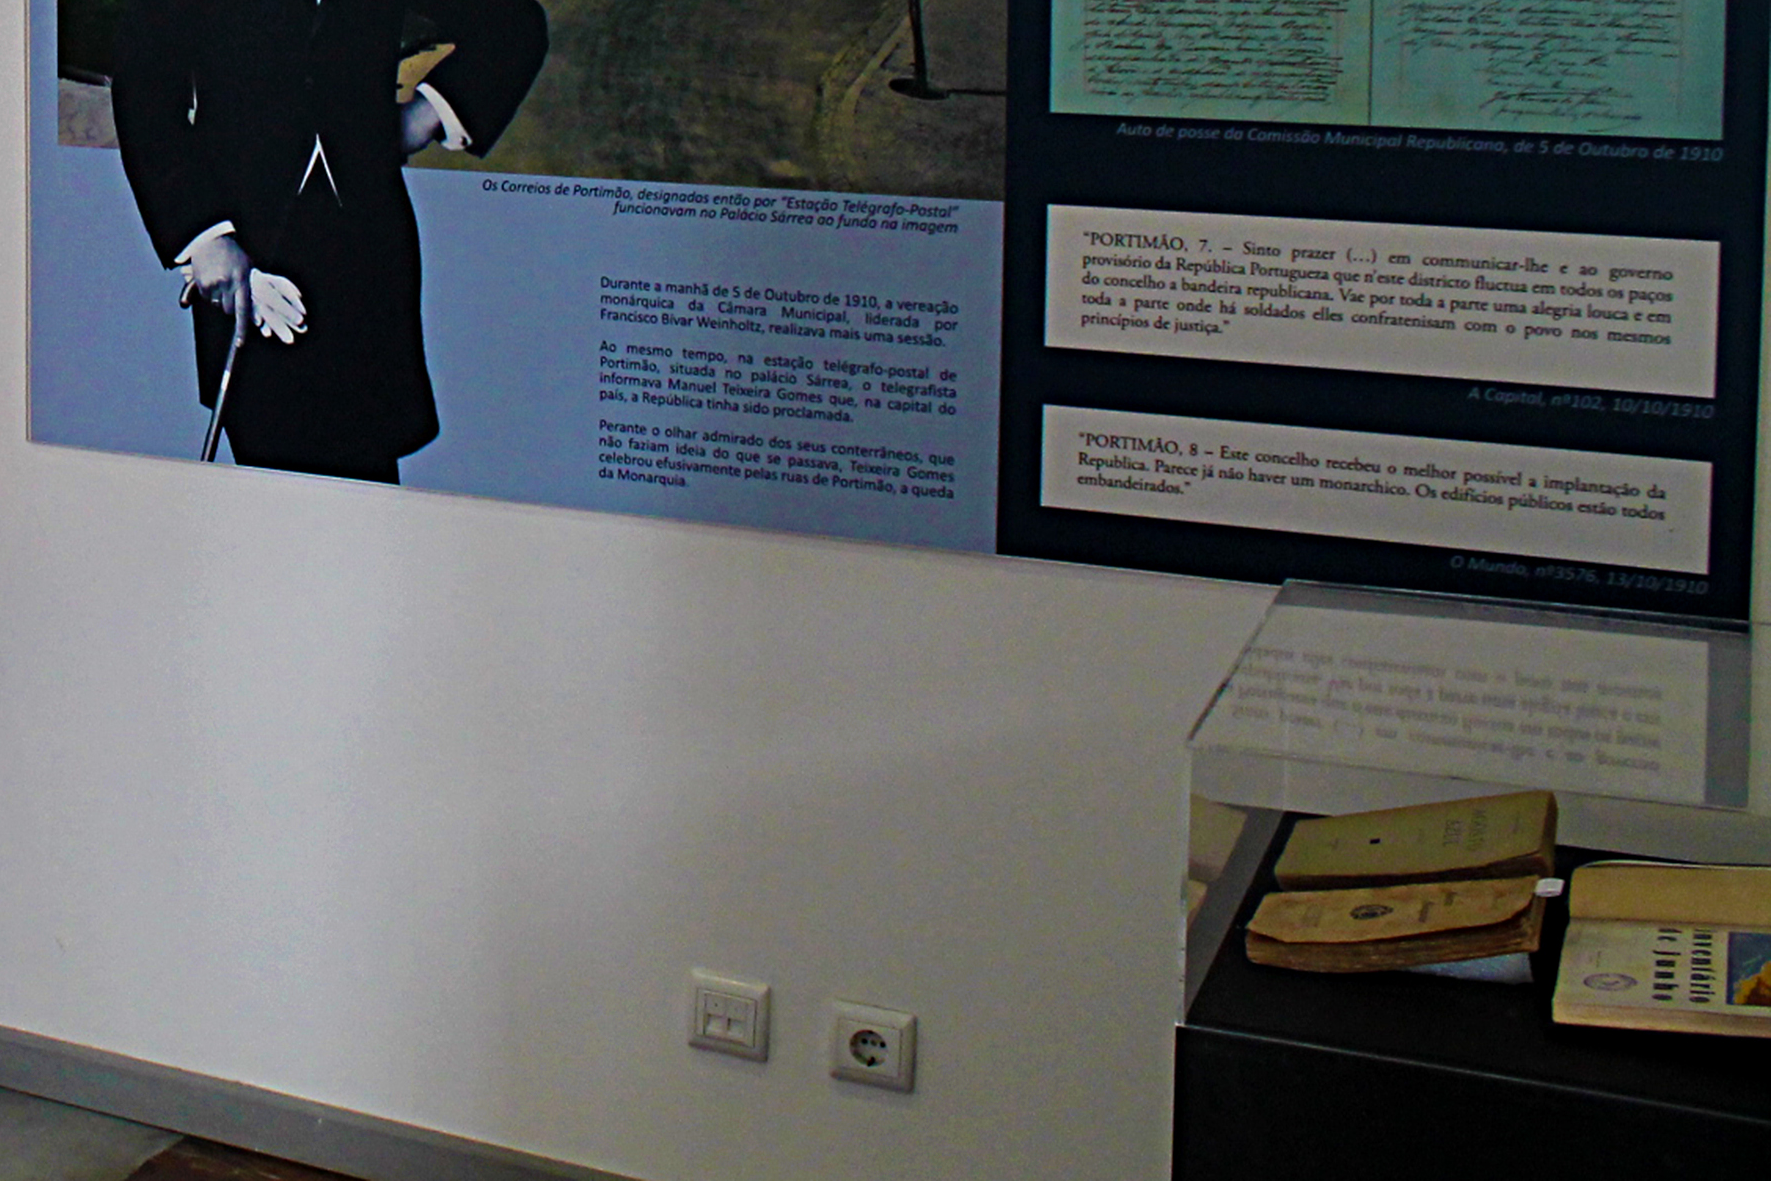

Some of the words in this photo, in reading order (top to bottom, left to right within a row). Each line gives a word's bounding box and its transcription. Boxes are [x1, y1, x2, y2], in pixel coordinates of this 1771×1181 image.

[482, 180, 497, 192] Os
[500, 181, 550, 195] Correios
[554, 183, 569, 196] de
[572, 184, 632, 203] Portimão,
[637, 188, 709, 207] designados
[712, 192, 749, 206] então
[753, 197, 775, 211] por
[612, 202, 696, 221] funcionavam
[699, 210, 717, 220] no
[719, 208, 767, 223] Palácio
[770, 211, 813, 226] Sárrea
[816, 216, 834, 227] ao
[836, 214, 877, 231] fundo
[880, 220, 898, 231] na
[901, 218, 958, 237] imagem
[1198, 238, 1211, 252] 7.
[1242, 240, 1281, 256] Sinto
[1290, 248, 1335, 263] prazer
[1387, 254, 1411, 264] em
[1421, 251, 1548, 272] communicar-lhe
[1558, 264, 1568, 273] e
[1579, 265, 1598, 275] ao
[1608, 267, 1673, 283] governo
[599, 293, 674, 313] monárquica
[687, 299, 704, 313] da
[717, 301, 766, 317] Câmara
[781, 305, 849, 326] Municipal,
[865, 311, 919, 328] liderada
[934, 320, 958, 334] por
[600, 277, 650, 293] Durante
[654, 284, 661, 294] a
[665, 281, 709, 297] manhã
[712, 284, 729, 298] de
[732, 286, 740, 299] 5
[743, 286, 760, 300] de
[763, 288, 820, 305] Outubro
[822, 292, 839, 306] de
[845, 293, 880, 312] 1910,
[885, 299, 893, 310] a
[896, 297, 958, 317] vereação
[600, 309, 658, 326] Francisco
[695, 316, 764, 336] Weinholtz,
[768, 321, 825, 338] realizava
[829, 325, 860, 341] mais
[863, 331, 893, 343] uma
[897, 330, 945, 347] sessão.
[599, 340, 616, 354] Ao
[626, 346, 673, 359] mesmo
[681, 347, 727, 366] tempo,
[737, 355, 753, 365] na
[763, 353, 813, 373] estação
[939, 367, 957, 382] de
[599, 356, 659, 377] Portimão,
[669, 362, 715, 378] situada
[725, 370, 741, 381] no
[750, 369, 796, 388] palácio
[862, 381, 871, 391] o
[881, 379, 957, 401] telegrafista
[1188, 442, 1198, 456] 8
[1219, 444, 1249, 461] Este
[1254, 447, 1320, 467] concelho
[1325, 453, 1381, 473] recebeu
[1386, 464, 1397, 474] o
[1403, 460, 1457, 479] melhor
[1462, 465, 1522, 489] possível
[1528, 476, 1537, 487] a
[1543, 472, 1641, 500] implantação
[1646, 481, 1666, 498] da
